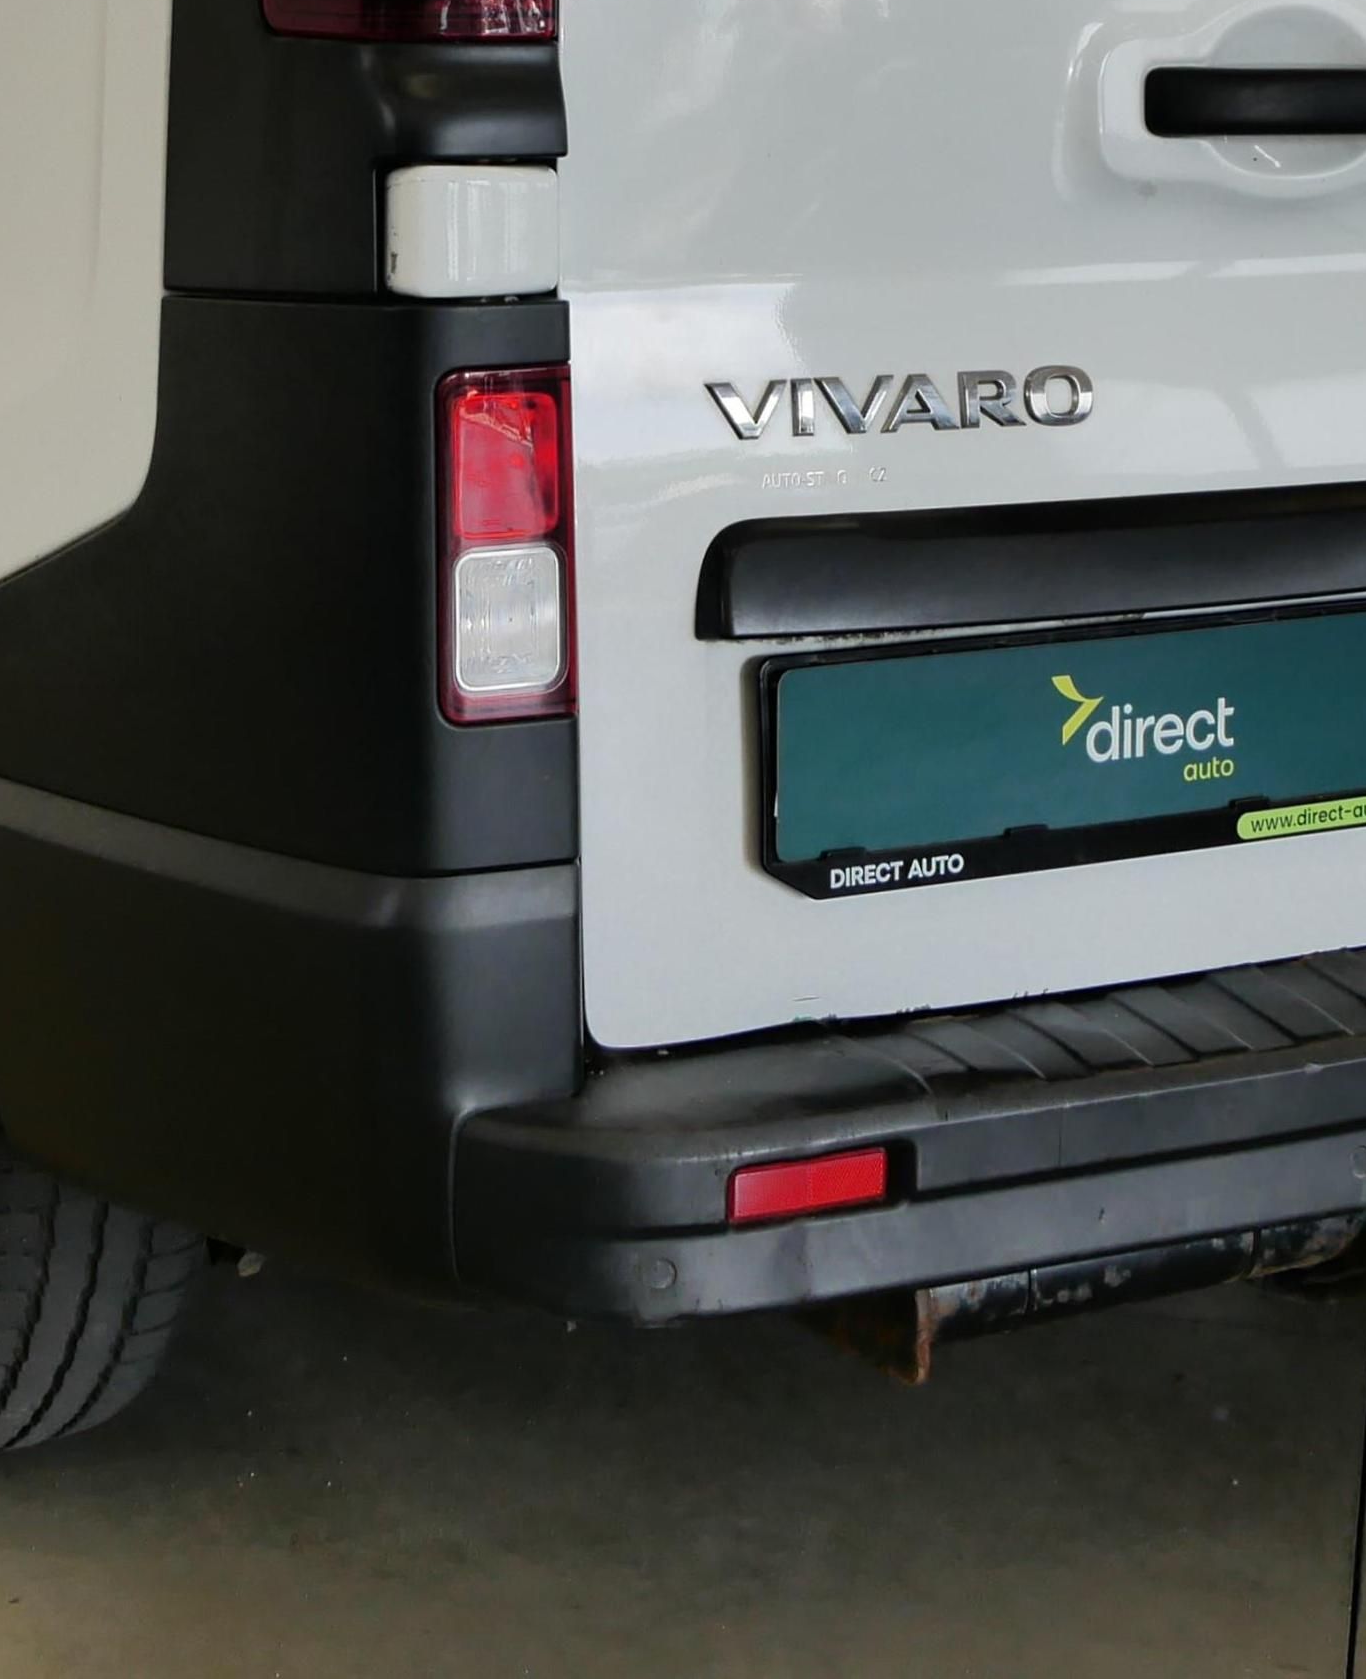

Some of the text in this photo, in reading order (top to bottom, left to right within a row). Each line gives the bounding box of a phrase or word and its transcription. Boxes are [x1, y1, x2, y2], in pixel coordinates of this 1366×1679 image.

[703, 364, 1095, 441] VIVARO
[1085, 696, 1235, 764] direct
[1183, 756, 1235, 782] auto
[830, 853, 965, 889] DIRECT AUTO
